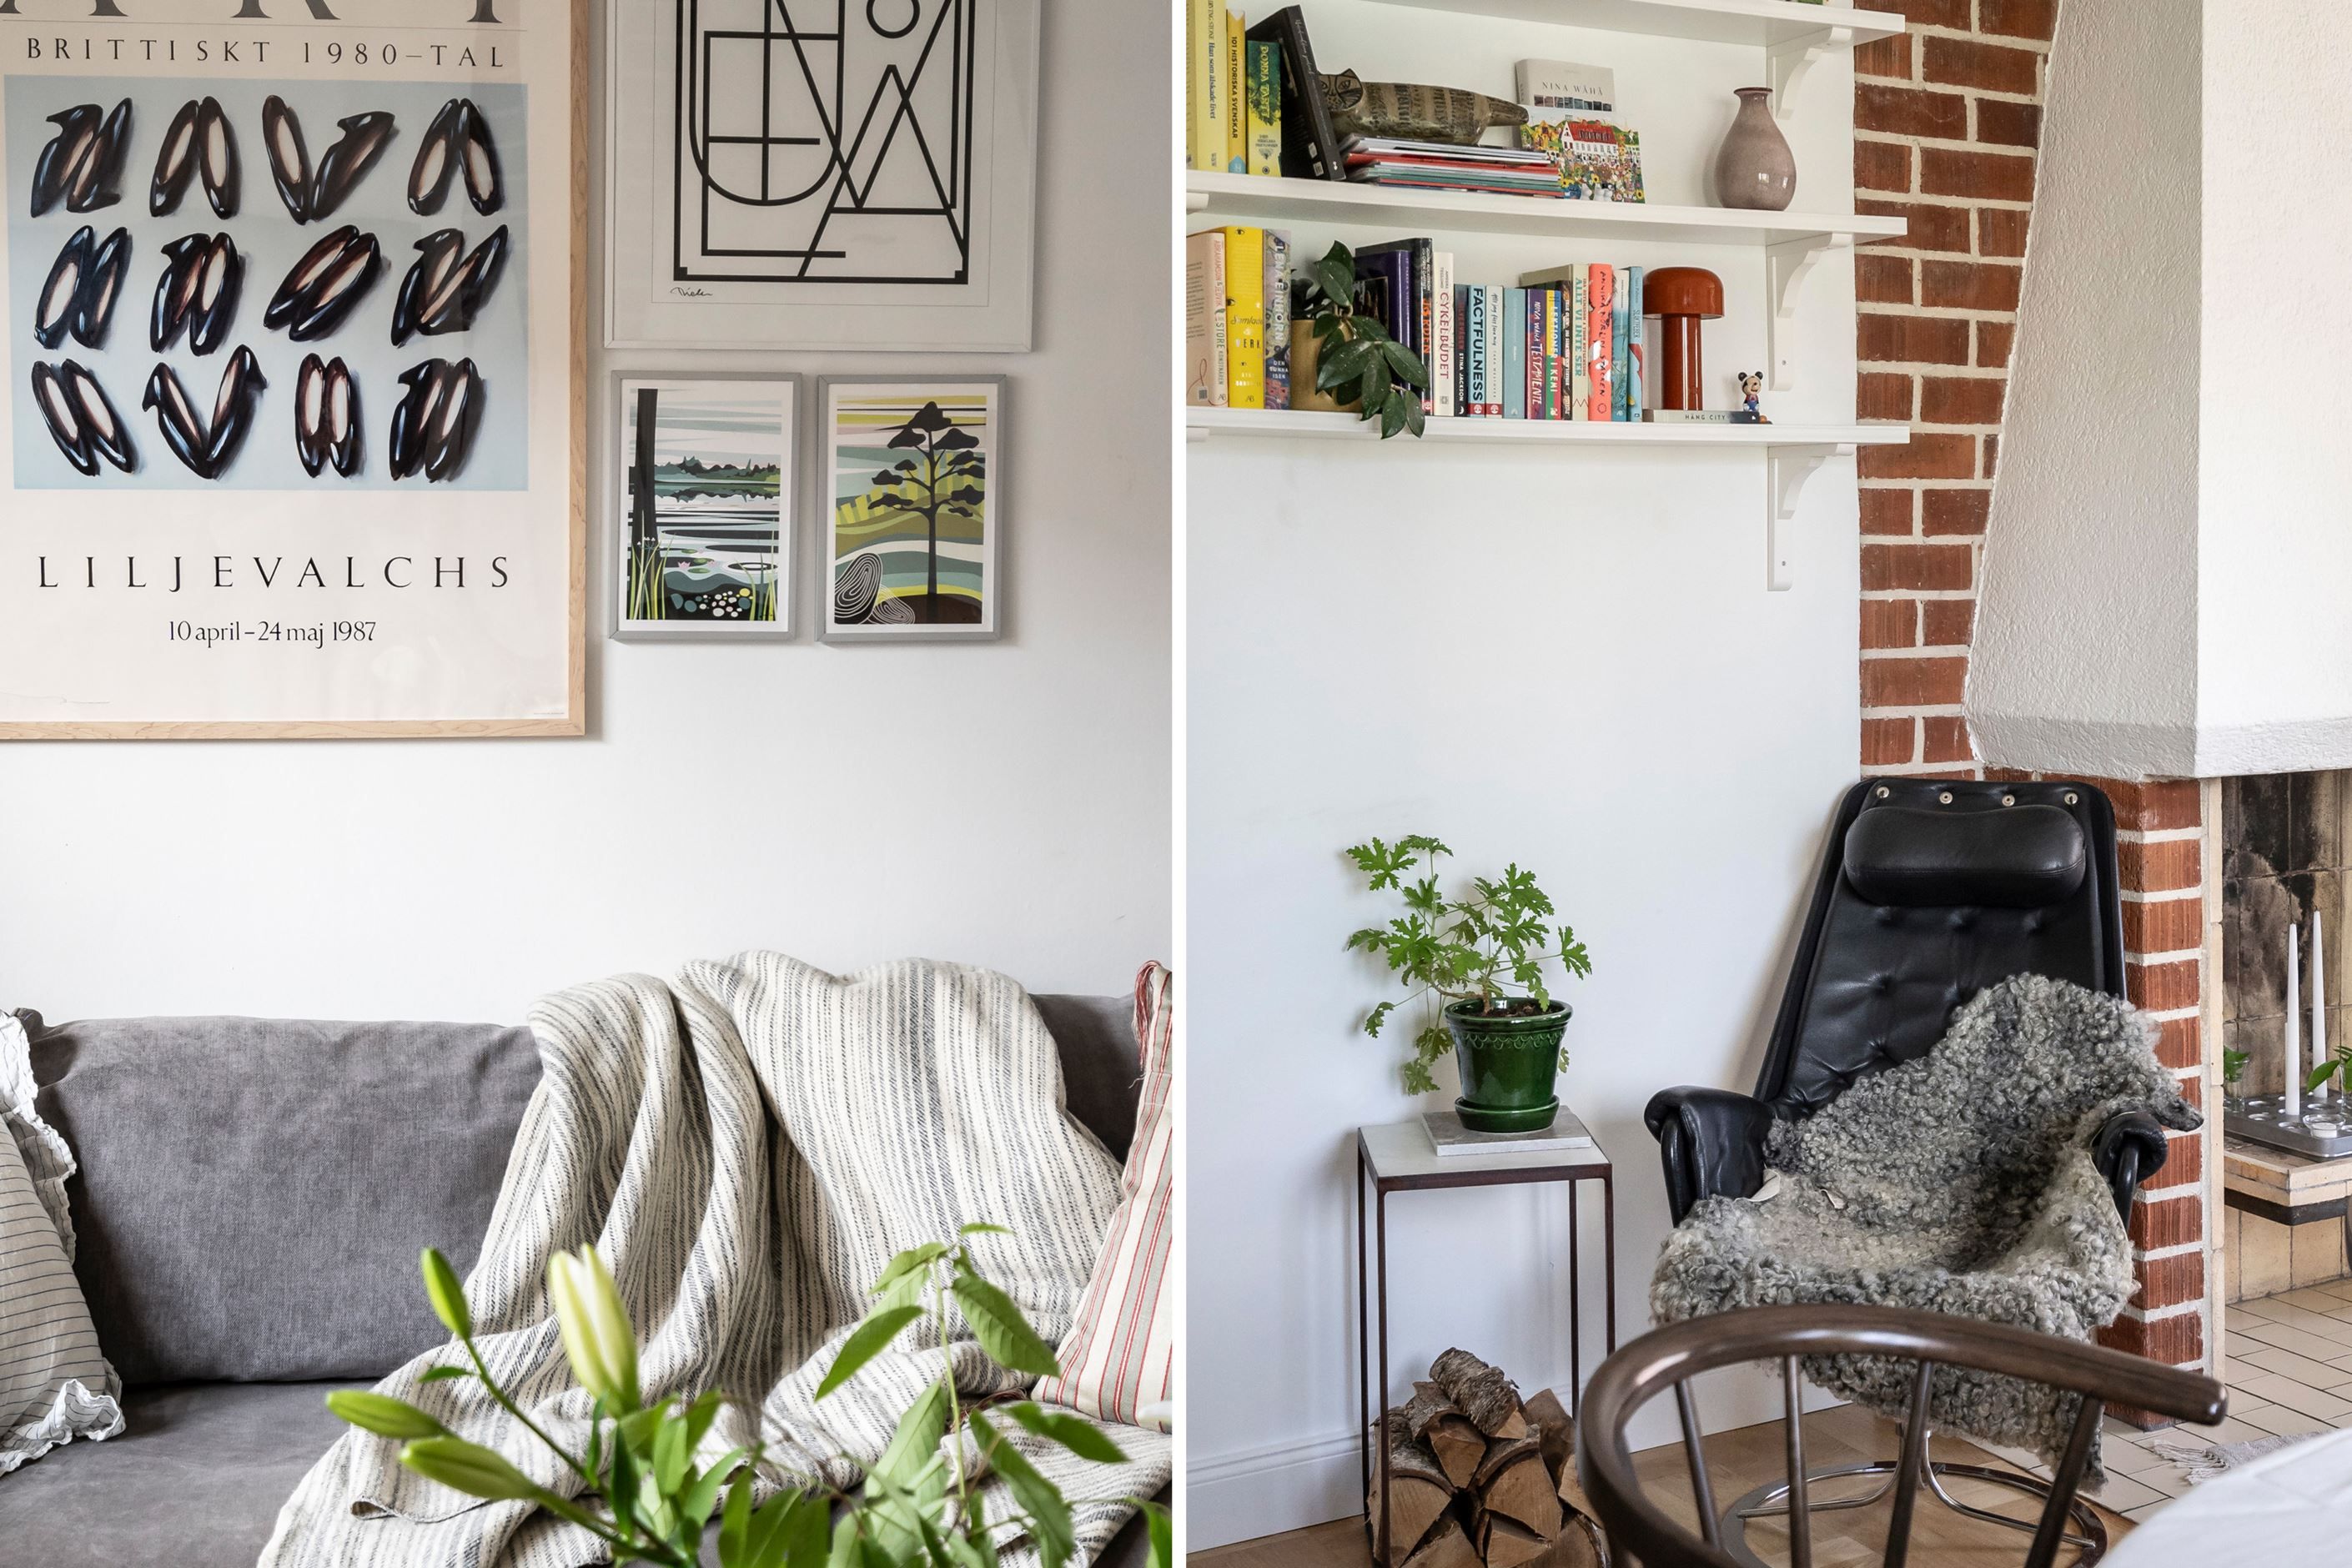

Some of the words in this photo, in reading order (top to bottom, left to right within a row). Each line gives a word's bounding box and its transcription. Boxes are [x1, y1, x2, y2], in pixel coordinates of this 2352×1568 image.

[27, 38, 270, 63] BRITTISKT
[1260, 45, 1269, 82] DONNA
[1260, 83, 1269, 118] TARTT
[1542, 82, 1569, 92] NINA
[1274, 245, 1285, 279] LENA
[1274, 282, 1284, 341] EINHORN
[1533, 301, 1541, 320] NINA
[1575, 309, 1582, 321] VI
[1216, 322, 1225, 349] STORE
[1440, 292, 1450, 379] CYKELBUDET
[1473, 288, 1484, 401] FACTFULNESS
[1550, 306, 1558, 359] LEKTIONER
[1530, 343, 1543, 405] TESTAMENTE
[1550, 369, 1558, 393] KEMI
[38, 555, 510, 593] LILJEVALCHS
[168, 621, 192, 641] 10
[286, 621, 324, 650] maj
[332, 621, 377, 642] 1987
